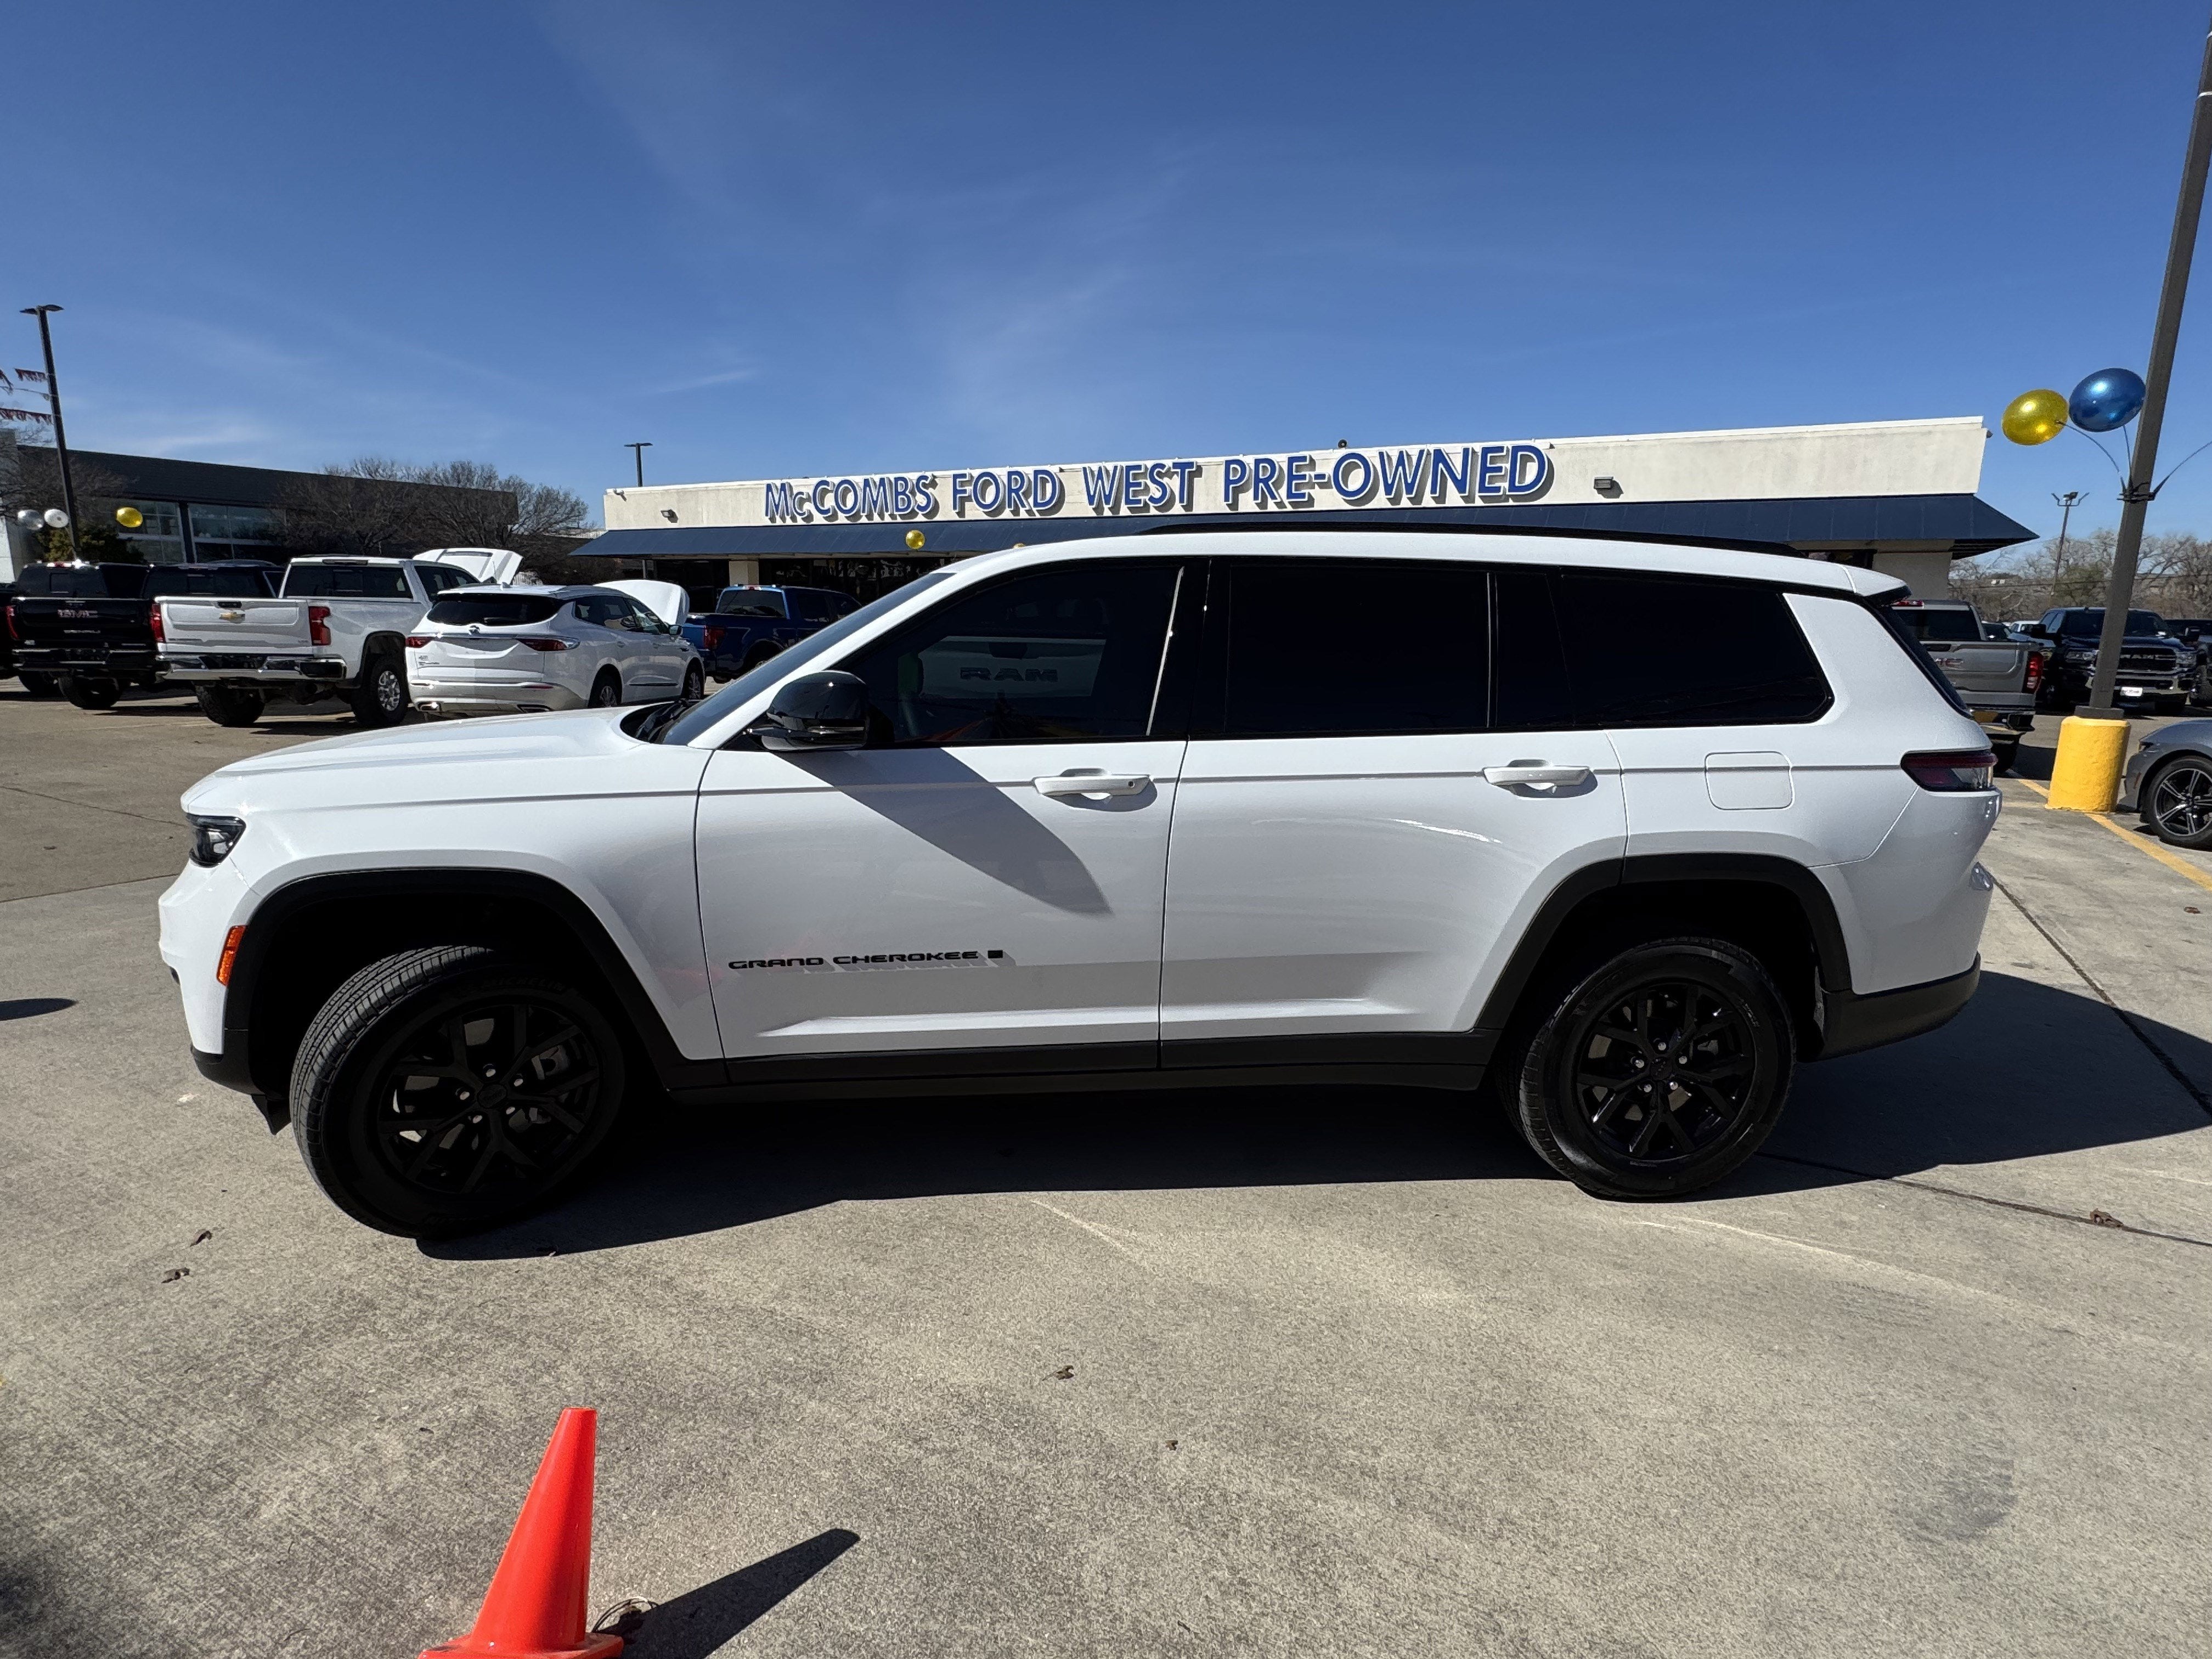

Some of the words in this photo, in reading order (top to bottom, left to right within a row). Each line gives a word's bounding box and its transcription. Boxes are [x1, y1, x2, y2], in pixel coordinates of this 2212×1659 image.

[765, 473, 934, 518] McCOMBS
[952, 469, 1059, 512] FORD
[1082, 461, 1195, 509] WEST
[1223, 444, 1549, 504] PRE-OWNED
[960, 667, 1058, 682] RAM
[729, 957, 824, 969] GRAND
[833, 950, 979, 964] CHEROKEE
